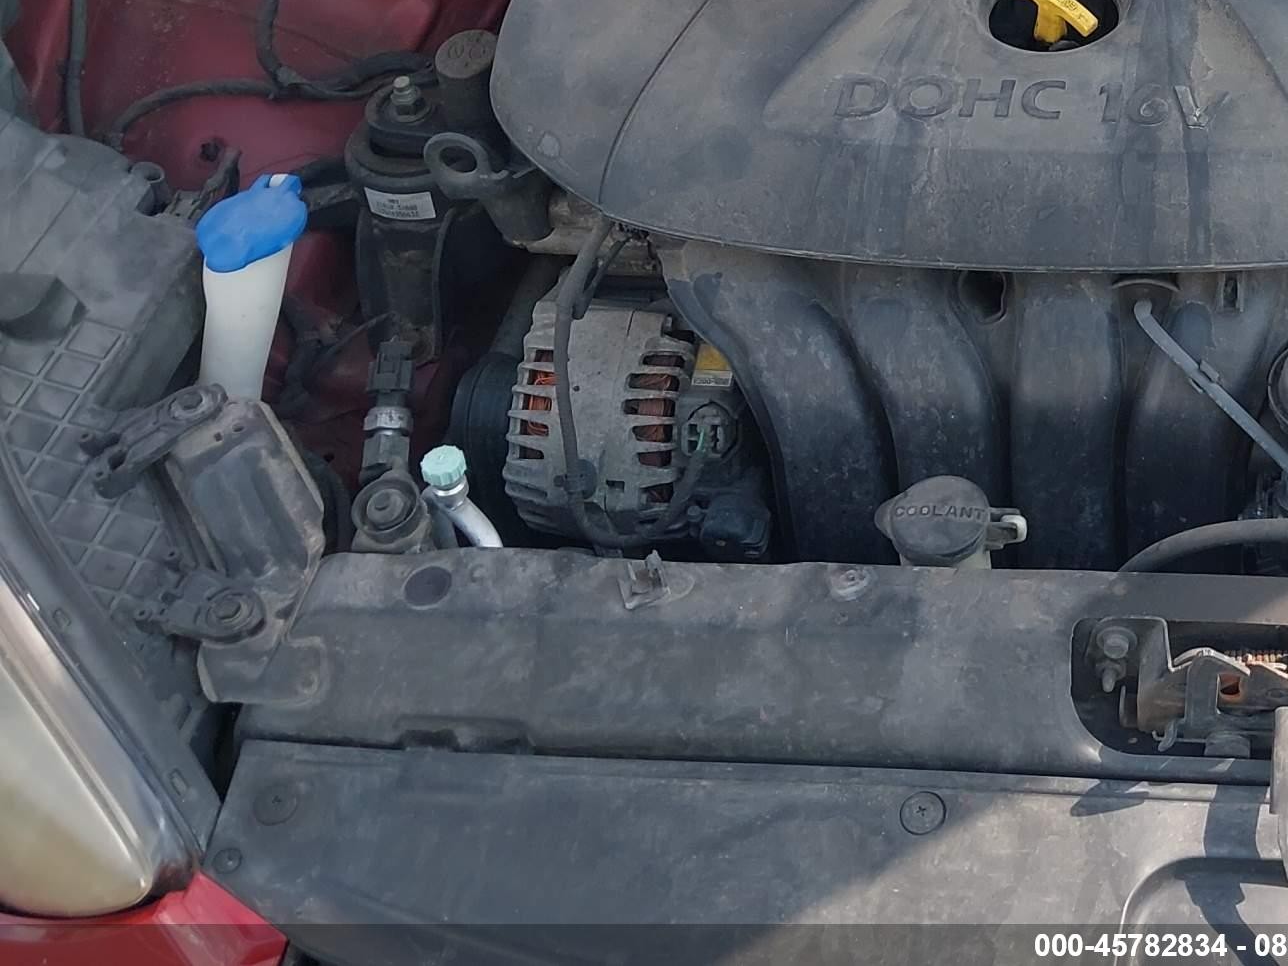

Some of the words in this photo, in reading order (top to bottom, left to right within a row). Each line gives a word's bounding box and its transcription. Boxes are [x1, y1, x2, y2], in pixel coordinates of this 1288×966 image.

[834, 74, 1067, 121] DOHC
[1098, 80, 1230, 129] 16V
[895, 505, 985, 520] COOLANT
